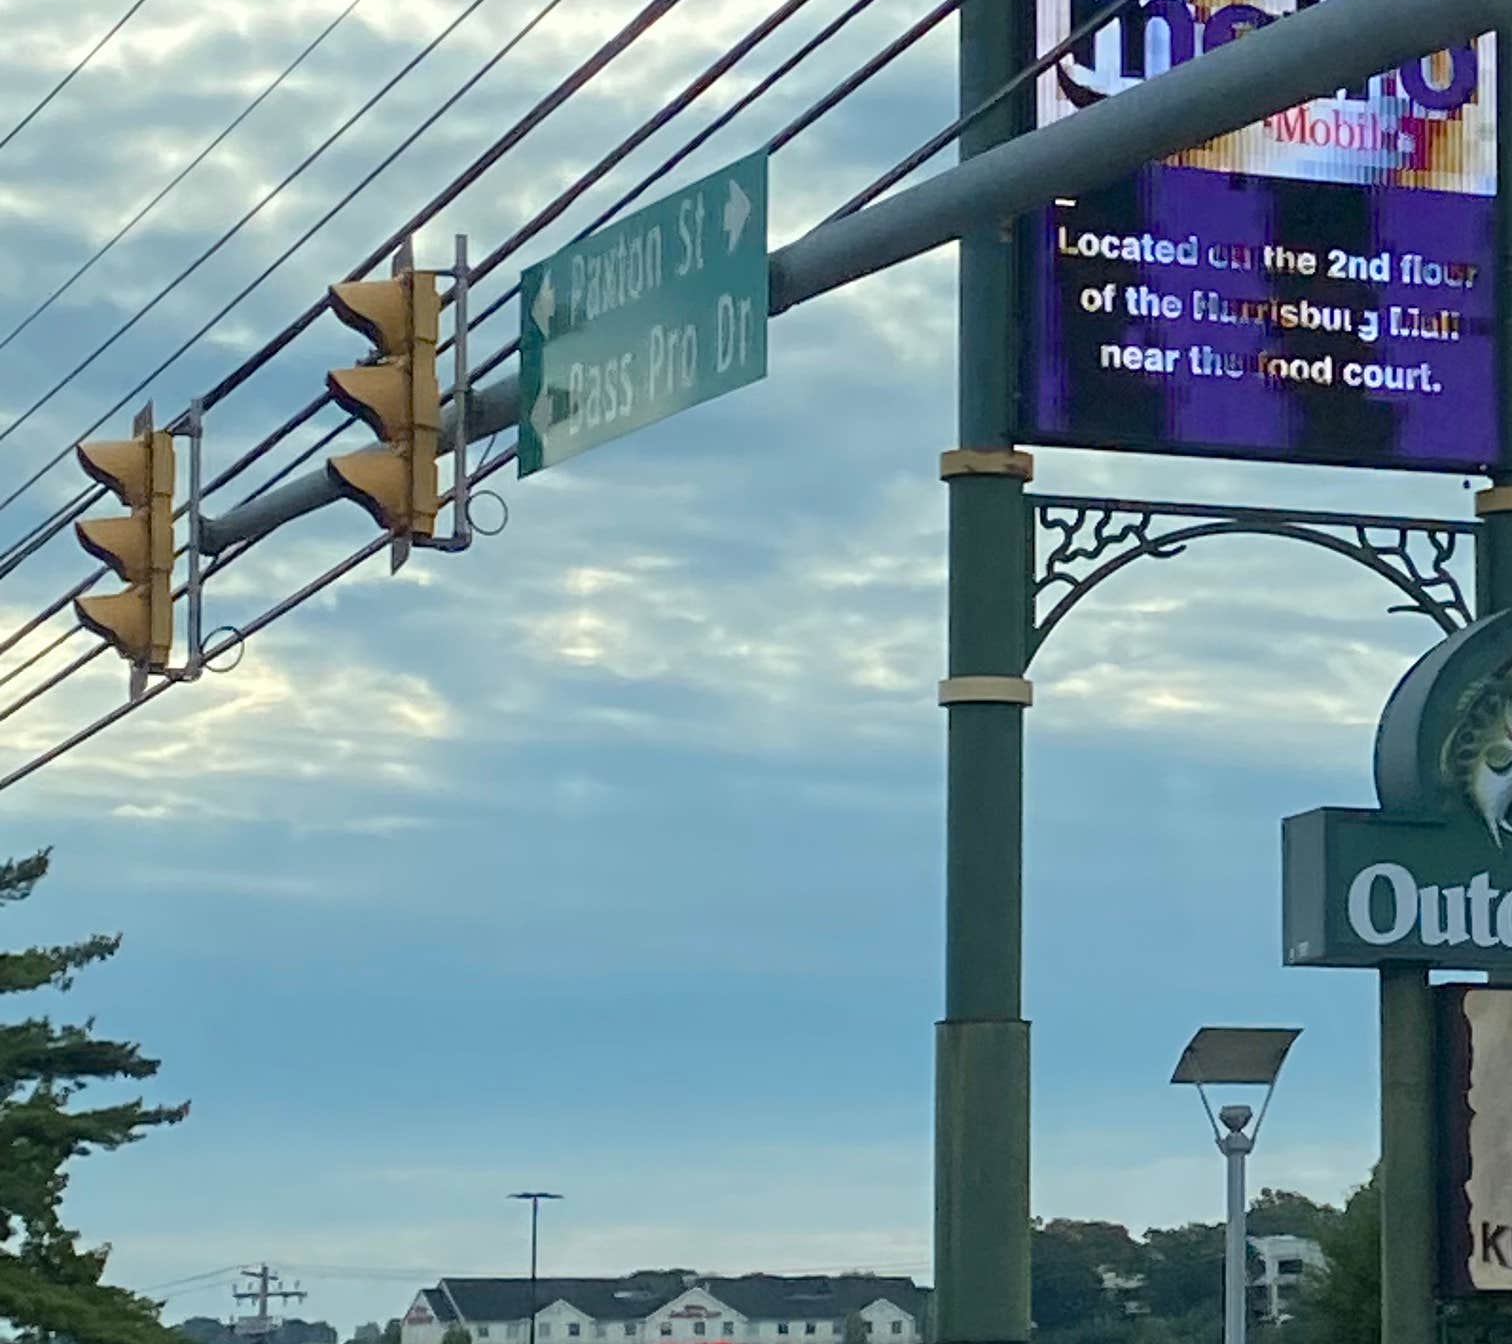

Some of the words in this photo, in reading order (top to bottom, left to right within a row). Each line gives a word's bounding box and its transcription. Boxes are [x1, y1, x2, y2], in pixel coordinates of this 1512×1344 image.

[569, 225, 663, 327] Paxton
[677, 192, 706, 277] St
[1059, 225, 1199, 266] Located
[1263, 244, 1317, 276] the
[1327, 248, 1391, 283] 2nd
[1080, 283, 1117, 312] of
[1125, 285, 1183, 319] the
[568, 351, 637, 437] Bass
[648, 324, 699, 401] Pro
[716, 293, 752, 374] Dr
[1100, 343, 1181, 373] near
[1342, 361, 1444, 394] court.
